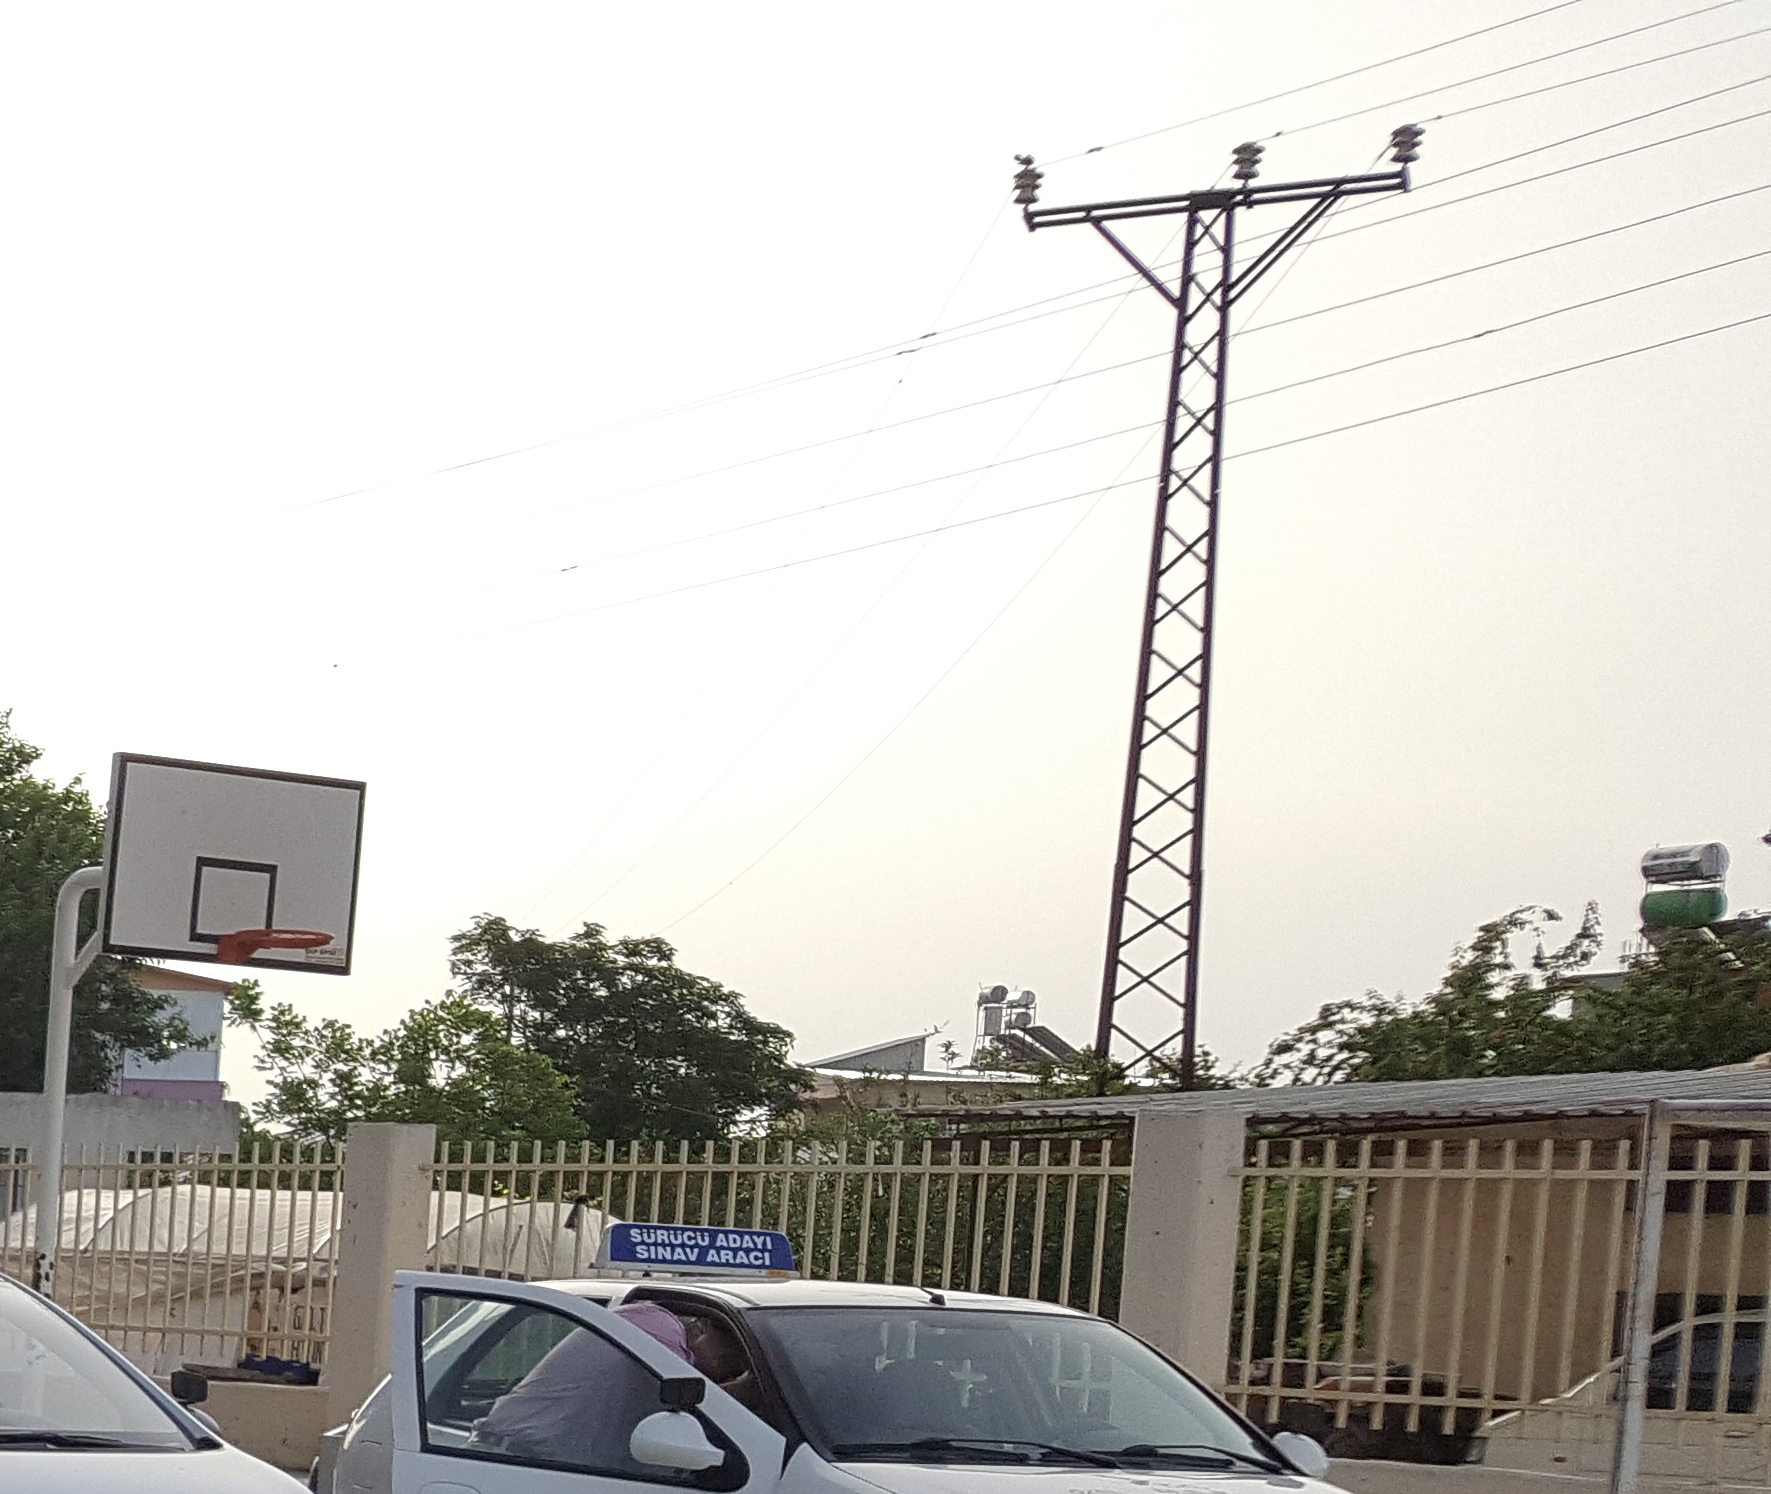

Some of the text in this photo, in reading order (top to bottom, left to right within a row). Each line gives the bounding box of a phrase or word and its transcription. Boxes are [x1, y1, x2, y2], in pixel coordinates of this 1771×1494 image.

[629, 1228, 773, 1250] SÜRÜCÜ ADAYI
[635, 1245, 771, 1266] SINAV ARACI
